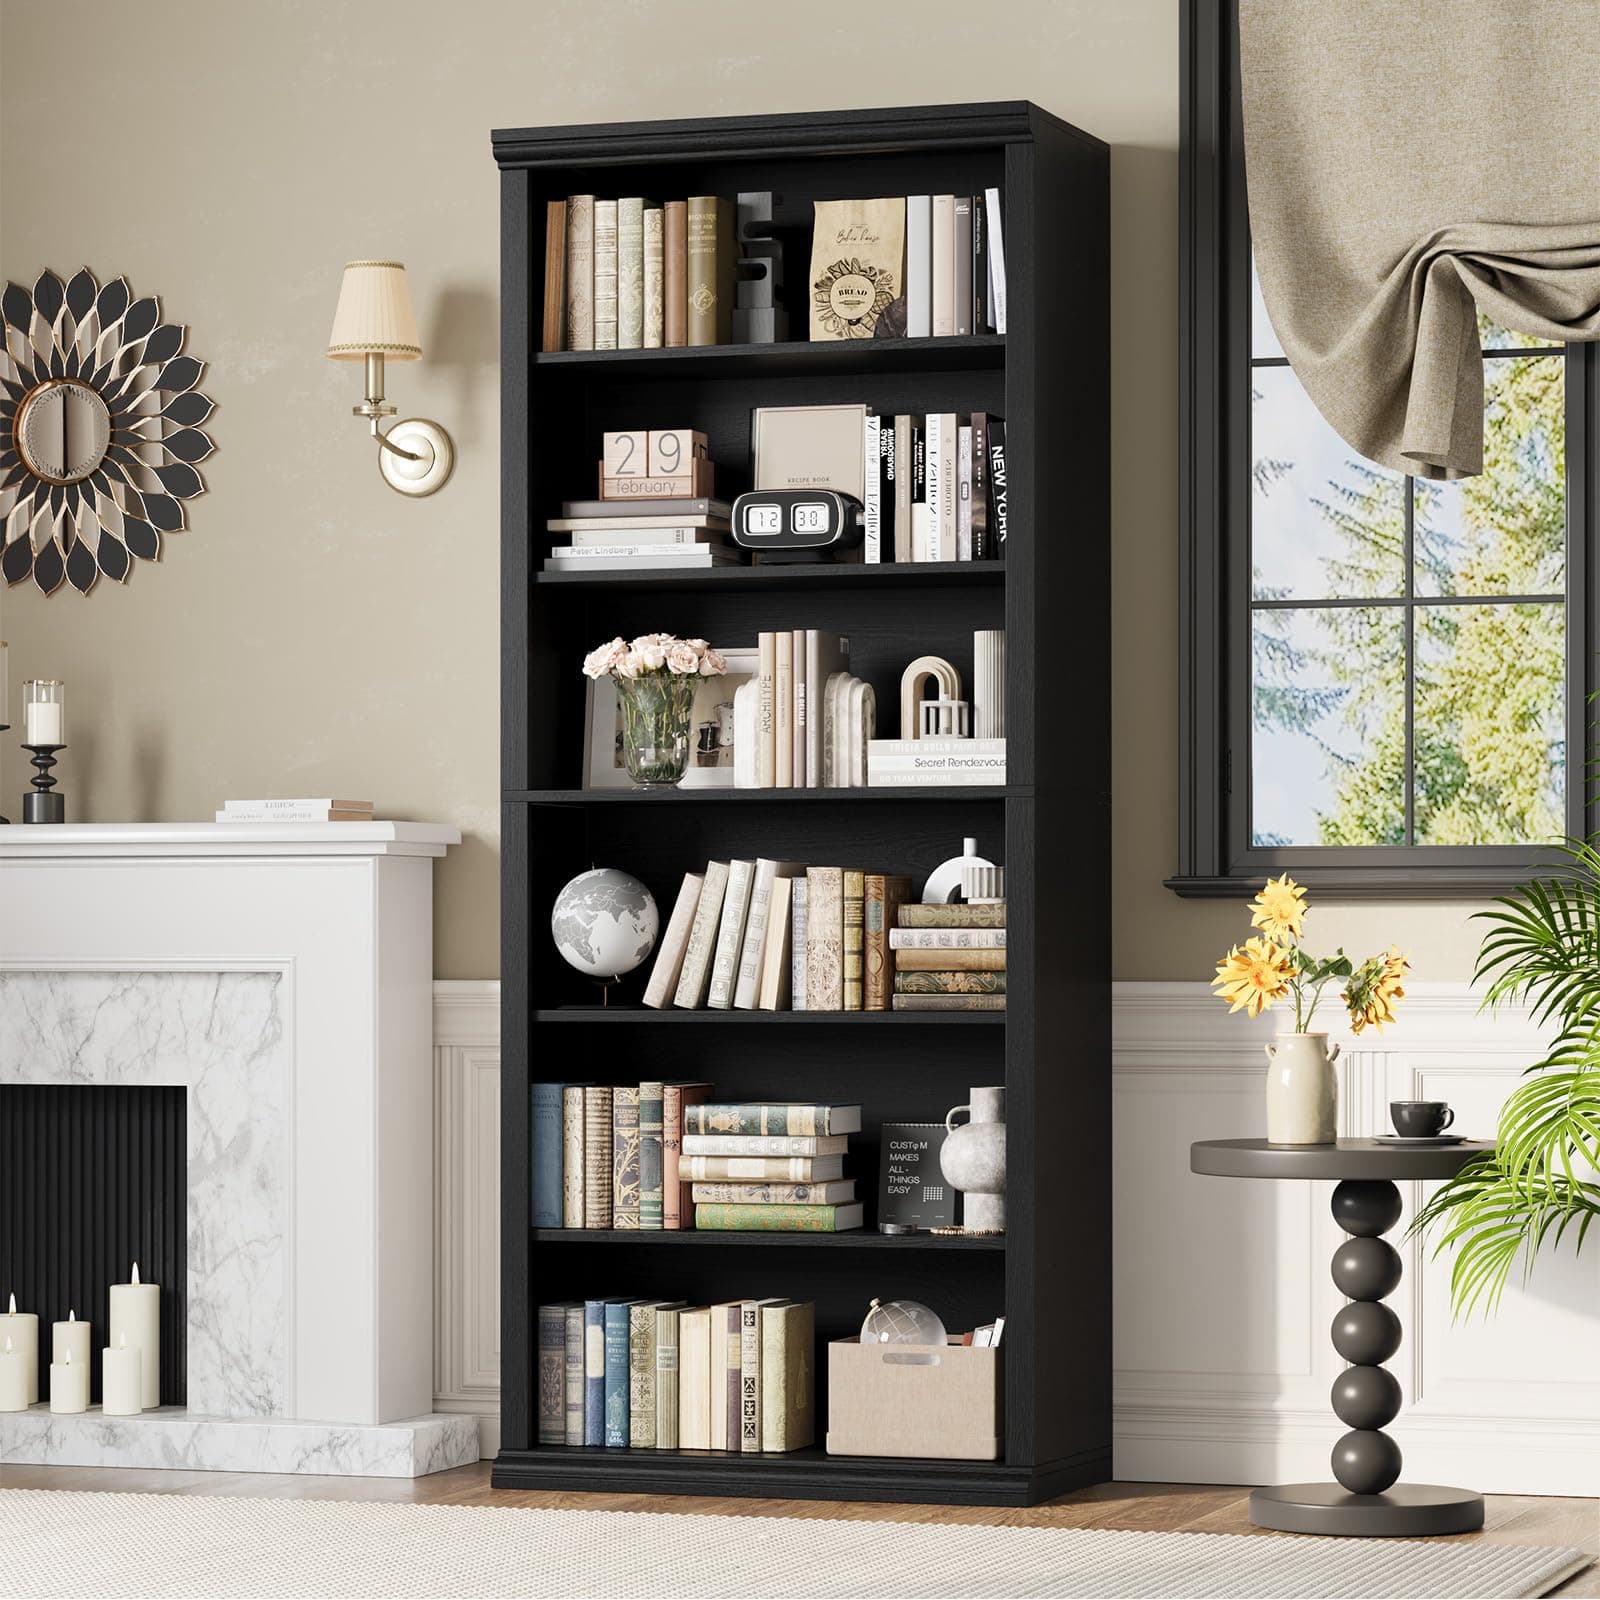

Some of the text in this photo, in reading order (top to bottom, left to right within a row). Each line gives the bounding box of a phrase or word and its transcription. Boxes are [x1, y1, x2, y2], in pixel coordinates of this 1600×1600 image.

[838, 288, 868, 297] BREAD
[992, 445, 1007, 487] NEW
[616, 479, 676, 496] february
[760, 510, 818, 527] 12 30
[570, 546, 639, 555] Peter Lindbergh
[914, 757, 1007, 767] Secret Rendezvous
[889, 1153, 920, 1162] MAKES
[888, 1165, 904, 1173] ALL
[888, 1176, 920, 1184] THINGS
[887, 1185, 911, 1194] EASY
